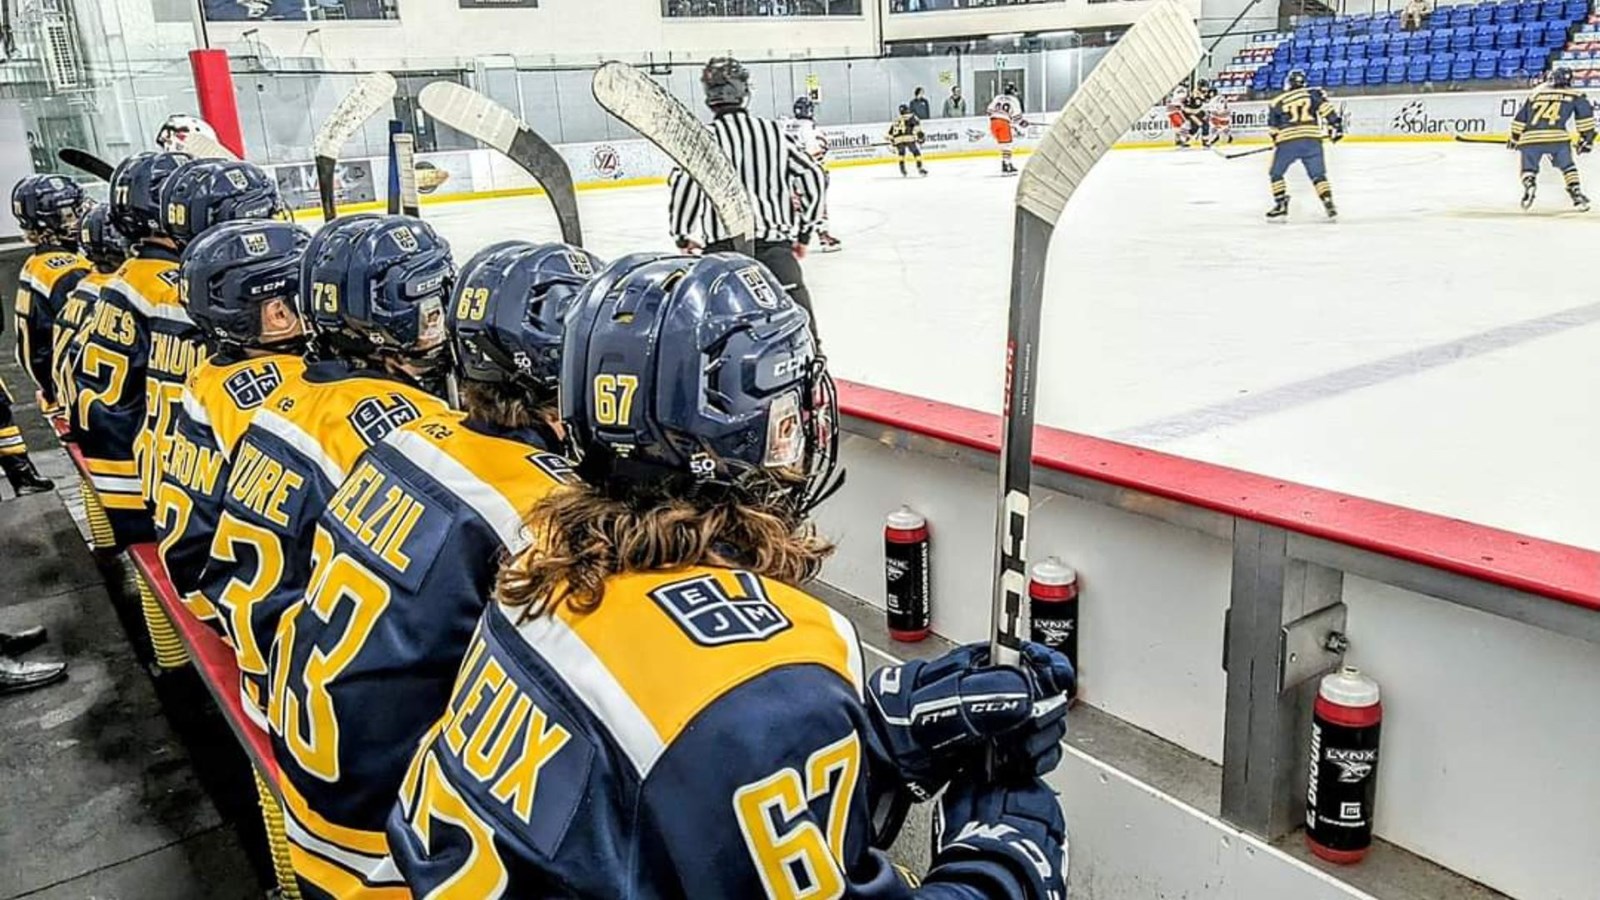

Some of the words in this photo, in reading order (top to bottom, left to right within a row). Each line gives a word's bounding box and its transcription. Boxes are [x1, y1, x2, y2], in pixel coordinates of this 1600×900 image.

[1531, 102, 1561, 126] 74
[251, 279, 287, 295] CCM
[312, 282, 338, 313] 73
[456, 287, 489, 321] 63
[594, 374, 638, 426] 67
[1033, 618, 1074, 630] LYNX
[970, 700, 1019, 713] CCM
[1326, 749, 1376, 760] LYNX
[732, 729, 862, 900] 67
